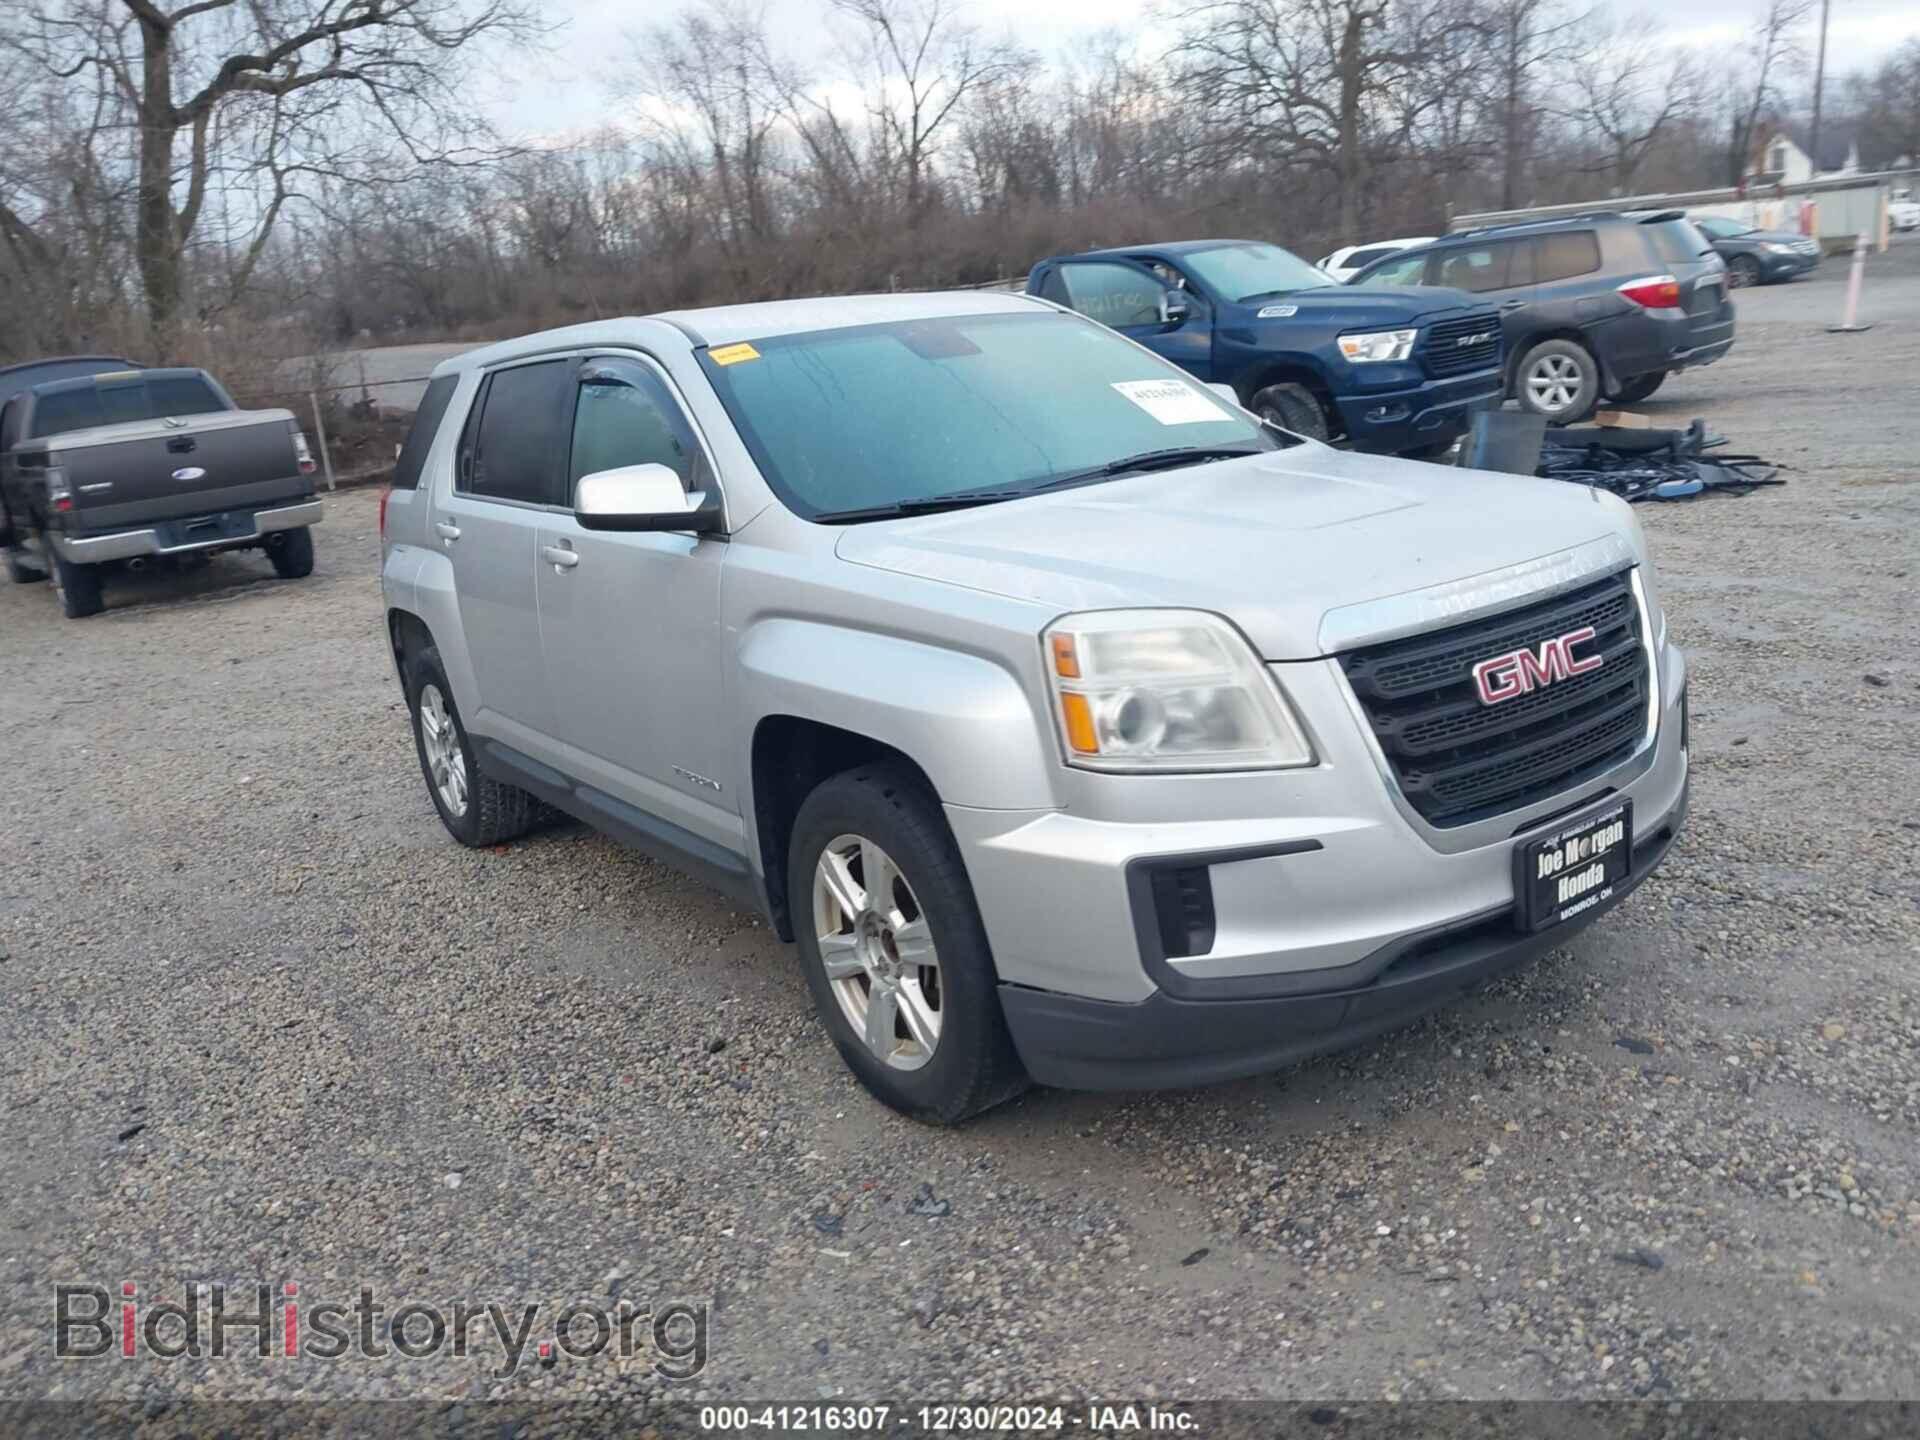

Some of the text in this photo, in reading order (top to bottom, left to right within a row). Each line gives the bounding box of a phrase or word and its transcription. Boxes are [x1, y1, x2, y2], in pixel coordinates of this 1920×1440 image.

[1473, 626, 1603, 706] GMC
[1538, 849, 1563, 879] Joe
[1565, 820, 1623, 866] Morgan
[1558, 863, 1604, 903] Honda
